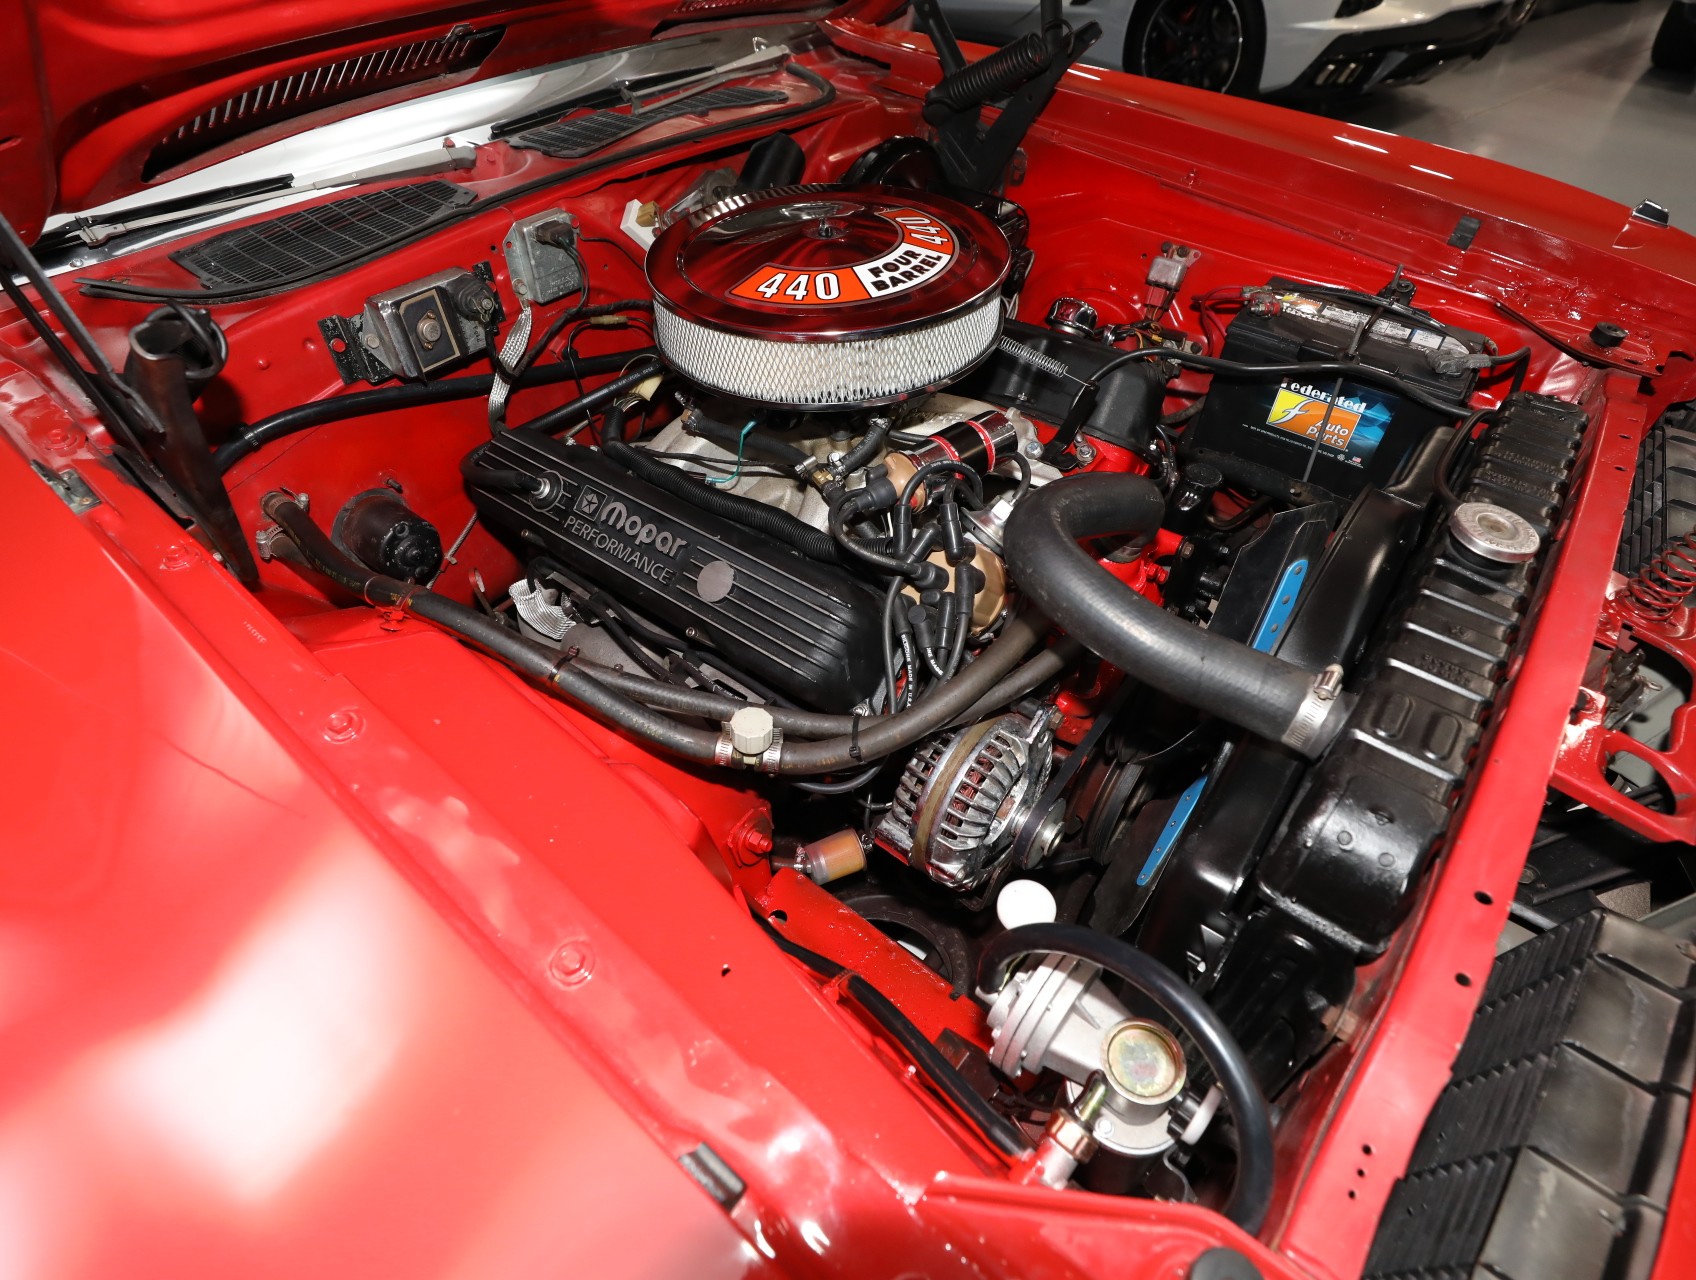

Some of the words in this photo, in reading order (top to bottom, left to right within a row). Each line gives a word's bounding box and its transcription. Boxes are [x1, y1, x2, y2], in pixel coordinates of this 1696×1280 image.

[895, 216, 949, 245] 440
[867, 249, 922, 279] FOUR
[870, 254, 943, 292] BARREL
[755, 271, 841, 301] 440
[600, 501, 688, 557] Mopar
[563, 515, 674, 585] PERFORMANCE
